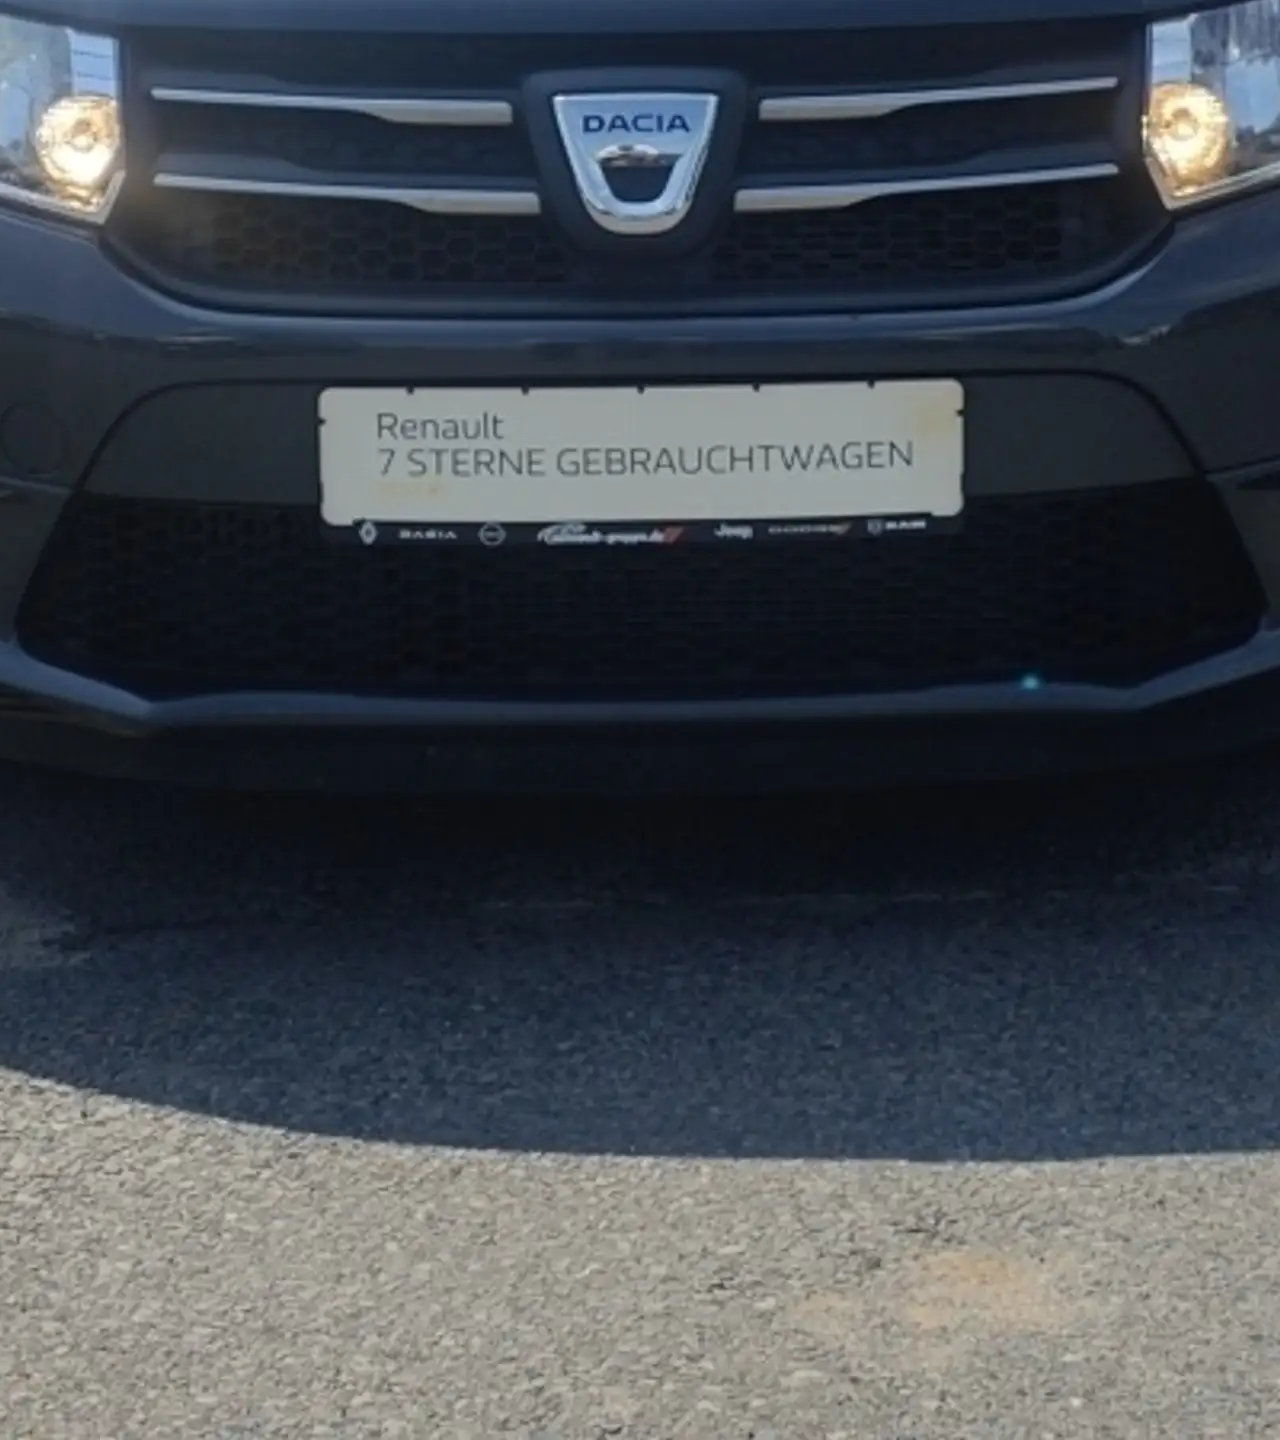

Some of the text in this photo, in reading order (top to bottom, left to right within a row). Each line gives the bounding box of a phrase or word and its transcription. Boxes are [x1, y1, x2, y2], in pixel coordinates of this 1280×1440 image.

[582, 113, 691, 134] DACIA
[376, 411, 505, 441] Renault
[378, 439, 915, 478] 7 STERNE GEBRAUCHTWAGEN
